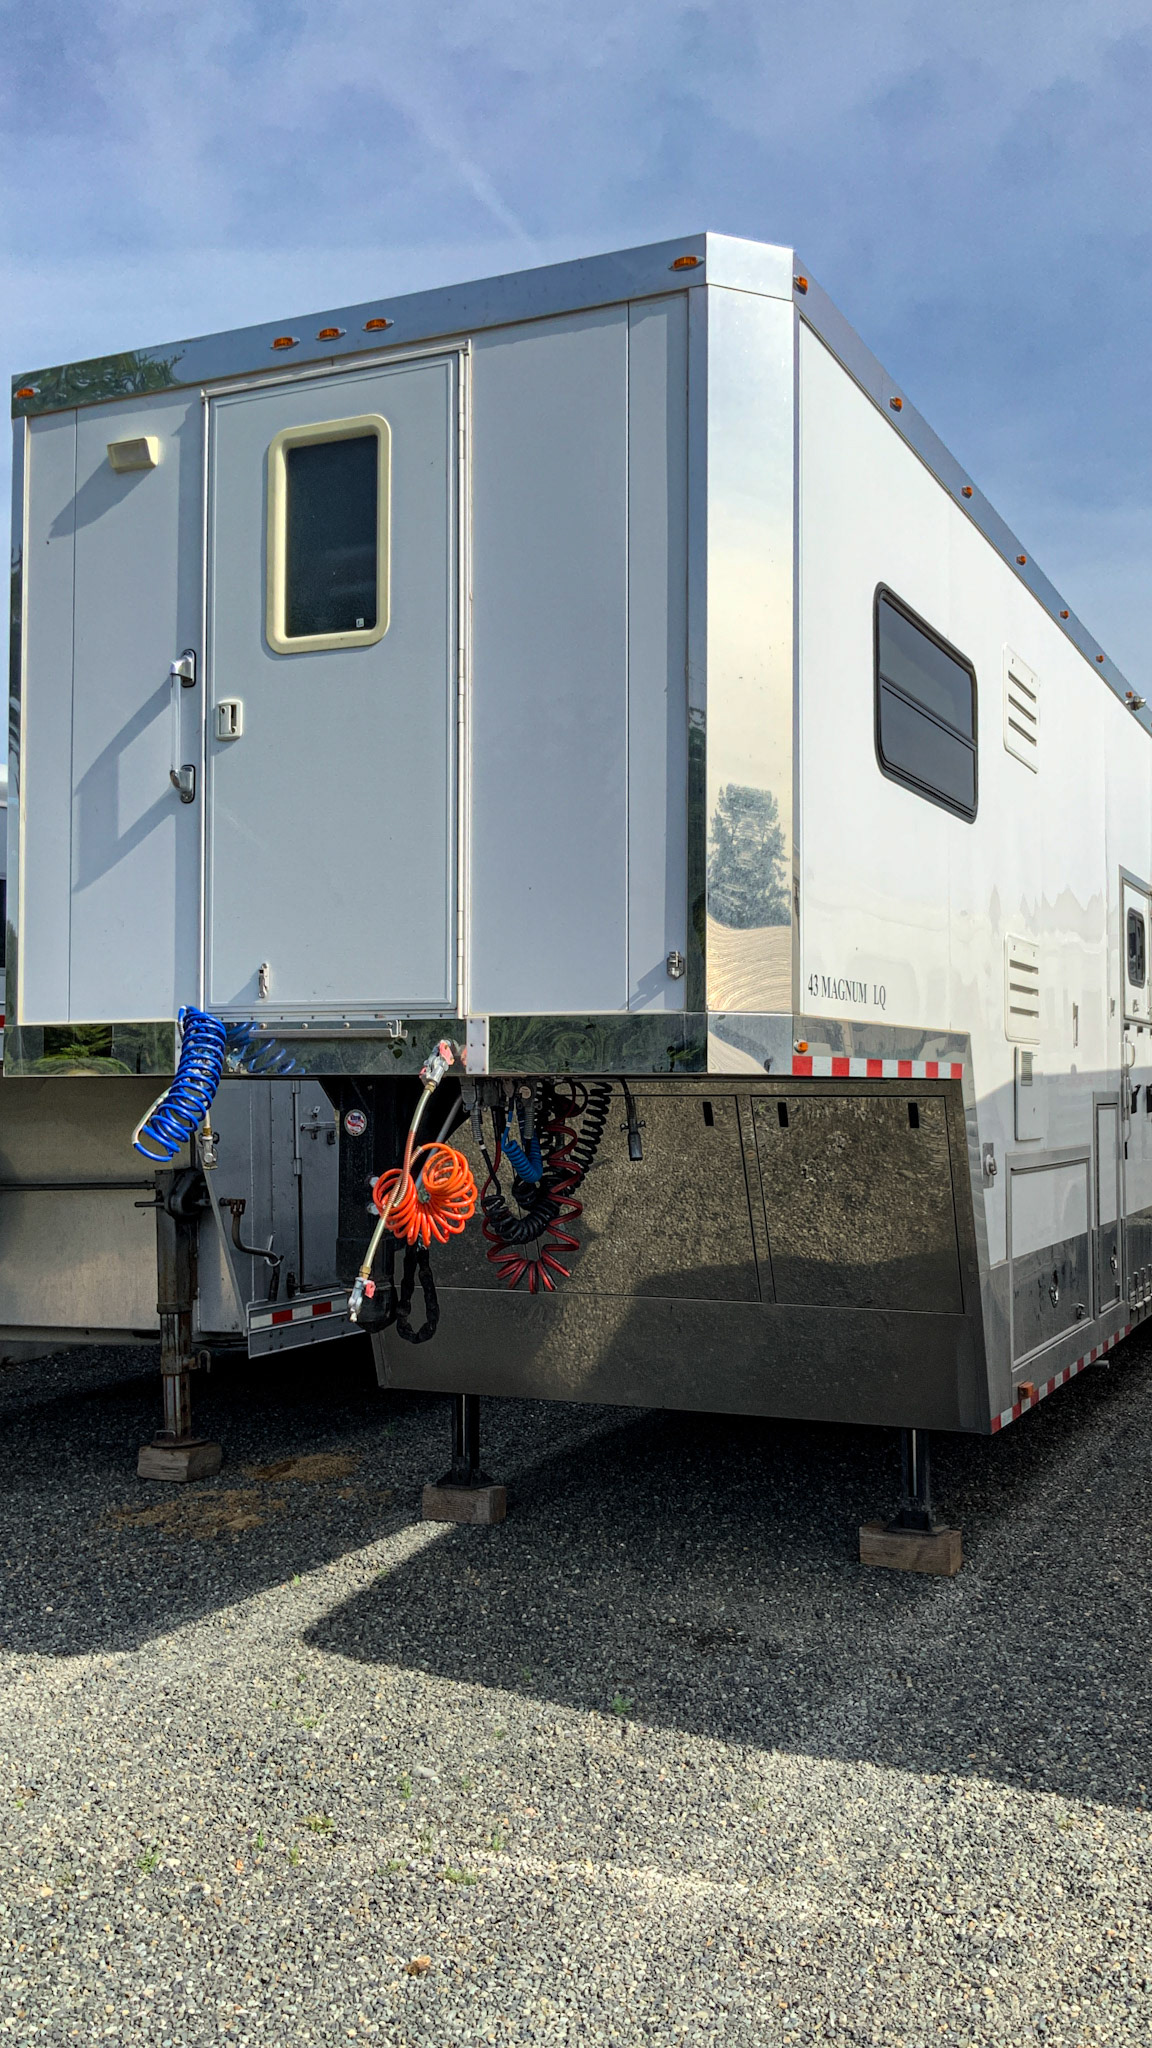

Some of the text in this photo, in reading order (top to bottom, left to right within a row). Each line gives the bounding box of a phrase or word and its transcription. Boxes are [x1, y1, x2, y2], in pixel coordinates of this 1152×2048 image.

[808, 973, 886, 1011] 43 MAGNUM LQ
